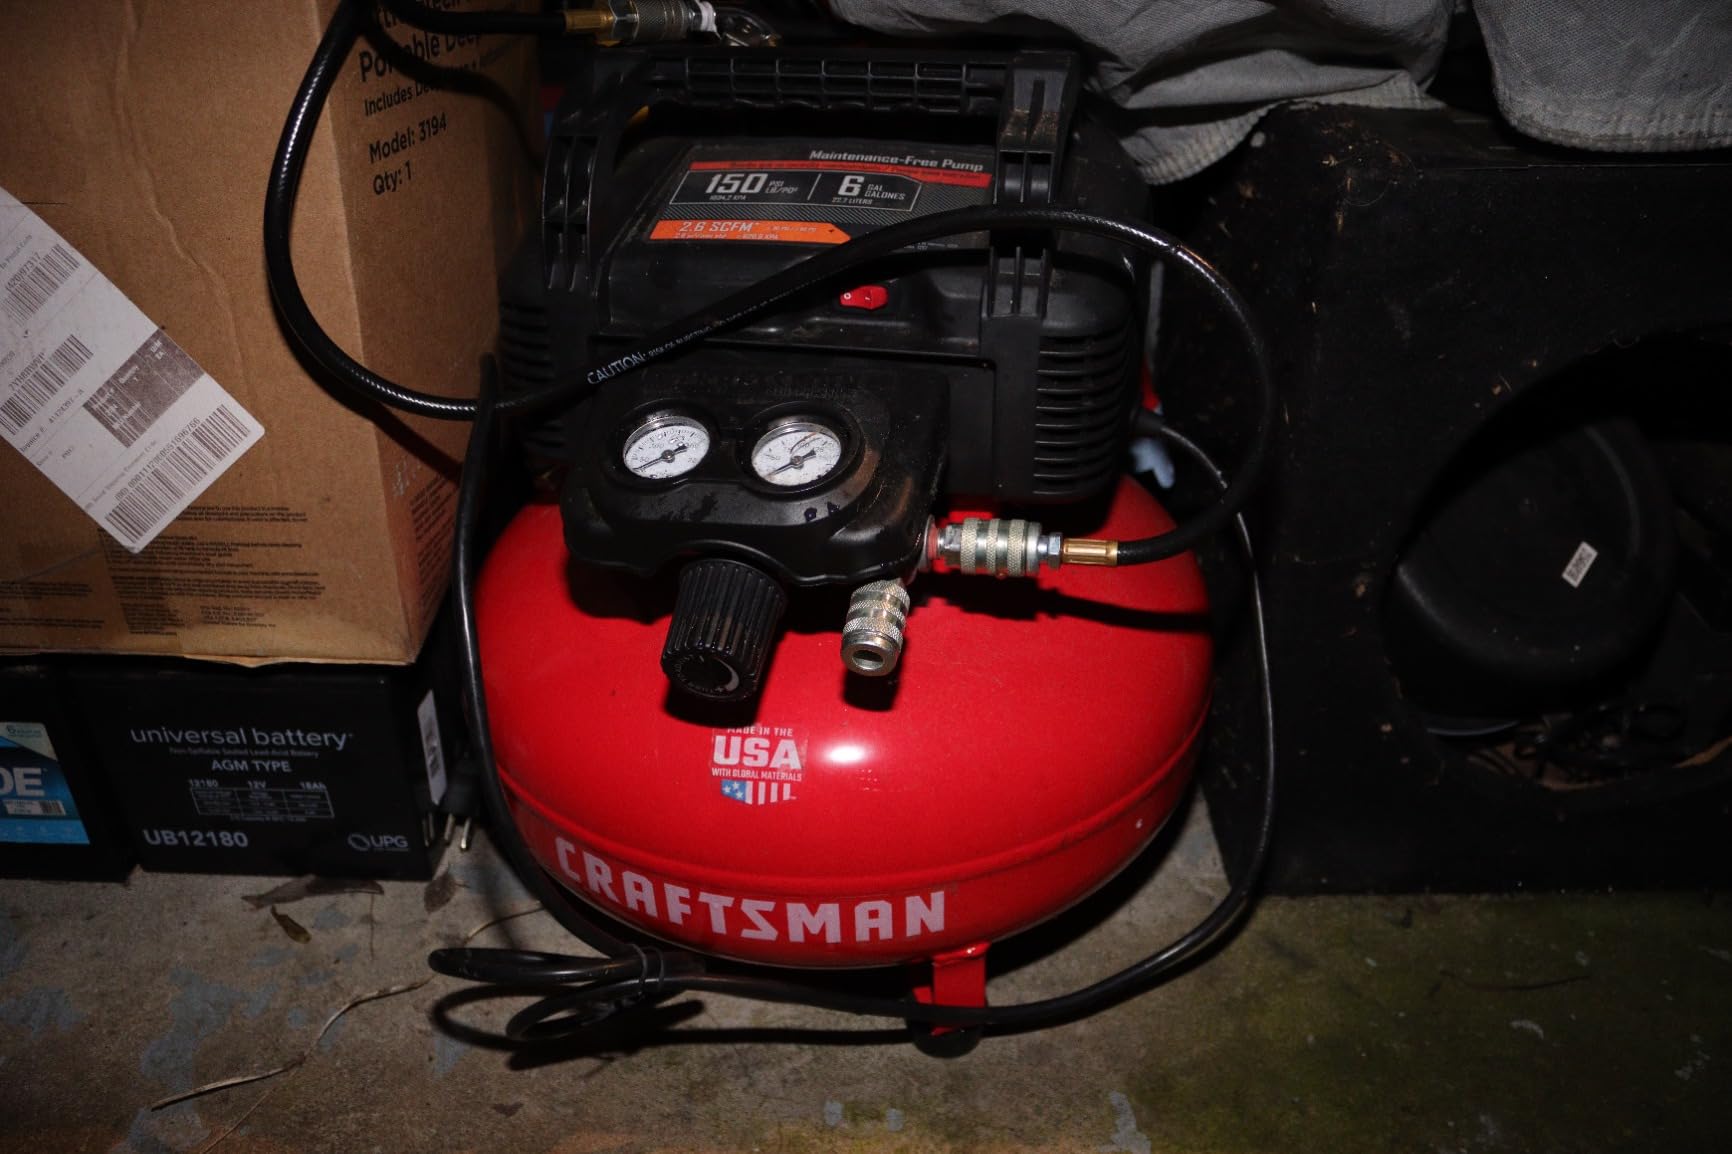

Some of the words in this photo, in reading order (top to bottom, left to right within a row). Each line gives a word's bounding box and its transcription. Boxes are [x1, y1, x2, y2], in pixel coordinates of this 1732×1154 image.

[364, 86, 413, 117] Includes
[369, 126, 416, 164] Model:
[418, 112, 447, 142] 3194
[809, 150, 938, 168] Maintenance-Free
[942, 158, 984, 172] Pump
[373, 168, 402, 195] Qty:
[405, 160, 412, 180] 1
[705, 173, 769, 194] 150
[837, 175, 865, 196] 6
[867, 183, 883, 191] GAL
[864, 190, 905, 201] GALONES
[679, 221, 705, 232] 2.6
[130, 726, 248, 745] universal
[252, 727, 347, 751] battery
[760, 727, 770, 736] IN
[774, 727, 793, 737] THE
[713, 735, 802, 770] USA
[211, 759, 249, 772] AGM
[251, 760, 292, 773] TYPE
[712, 767, 731, 777] WITH
[732, 768, 759, 779] GLOBAL
[761, 770, 802, 782] MATERIALS
[143, 829, 249, 848] UB12180
[370, 835, 409, 848] UPG
[555, 836, 946, 944] CRAFTSMAN
